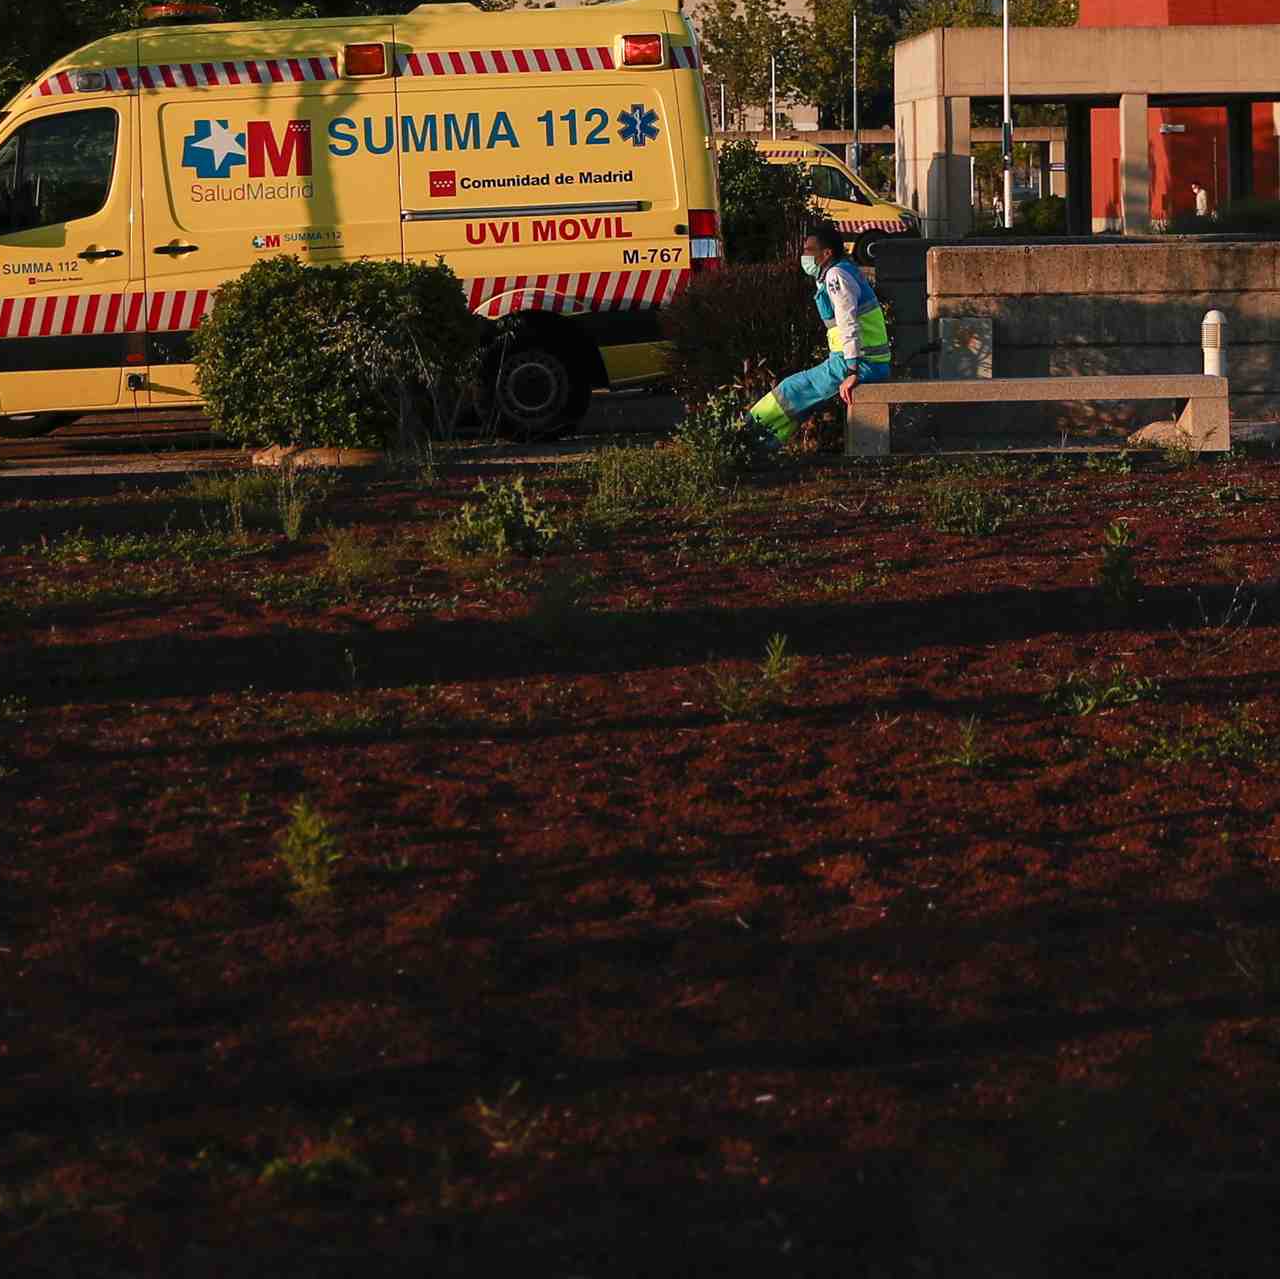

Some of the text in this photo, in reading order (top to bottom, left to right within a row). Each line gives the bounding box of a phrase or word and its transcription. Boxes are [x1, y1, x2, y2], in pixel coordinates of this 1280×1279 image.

[327, 107, 611, 156] SUMMA 112
[247, 119, 313, 178] M
[460, 170, 634, 190] Comunidad de Madrid
[191, 181, 314, 203] SaludMadrid
[283, 232, 321, 241] SUMMA
[465, 216, 633, 245] UVI MOVIL
[265, 234, 280, 248] M
[622, 247, 683, 265] M-767
[2, 261, 79, 275] SUMMA 112
